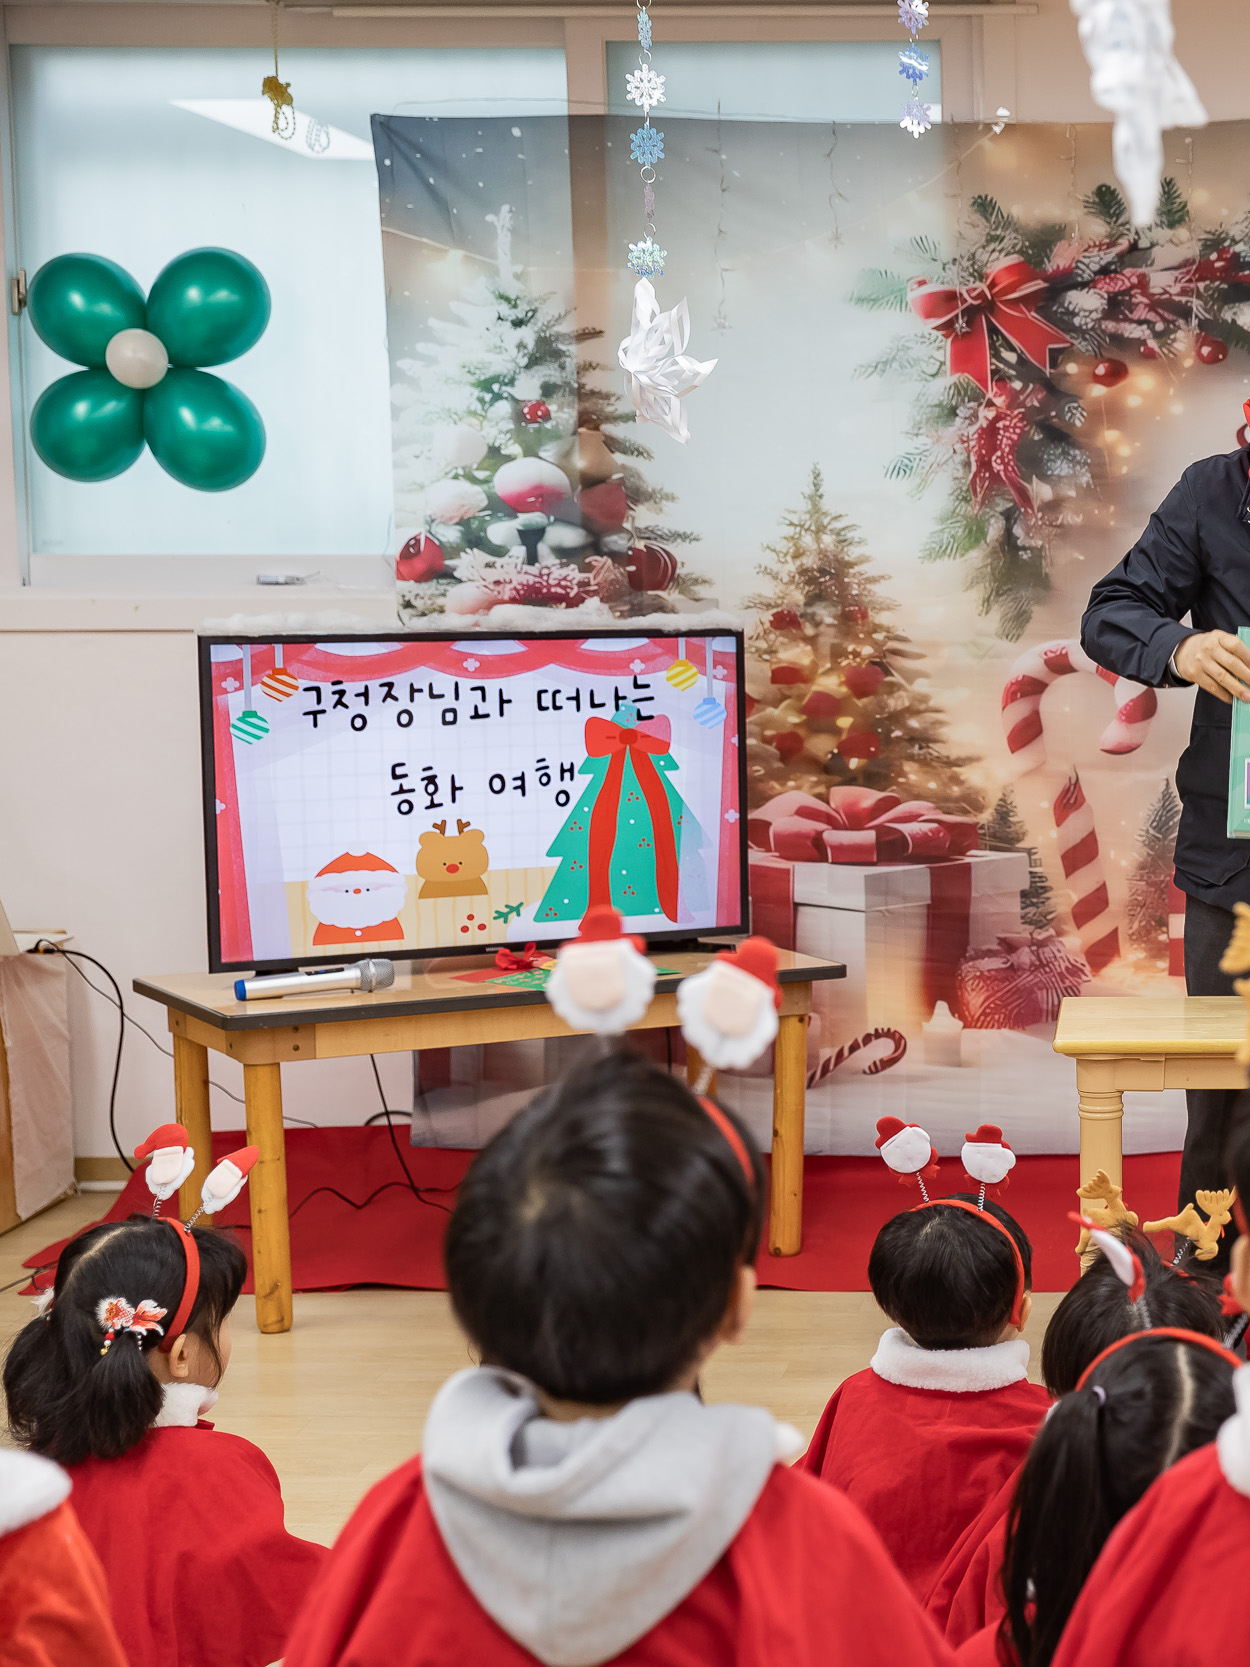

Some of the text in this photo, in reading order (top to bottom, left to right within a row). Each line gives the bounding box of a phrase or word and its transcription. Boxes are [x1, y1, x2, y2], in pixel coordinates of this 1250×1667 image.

[302, 675, 655, 732] 구청장님과 떠나는
[390, 758, 575, 815] 동화 여행
